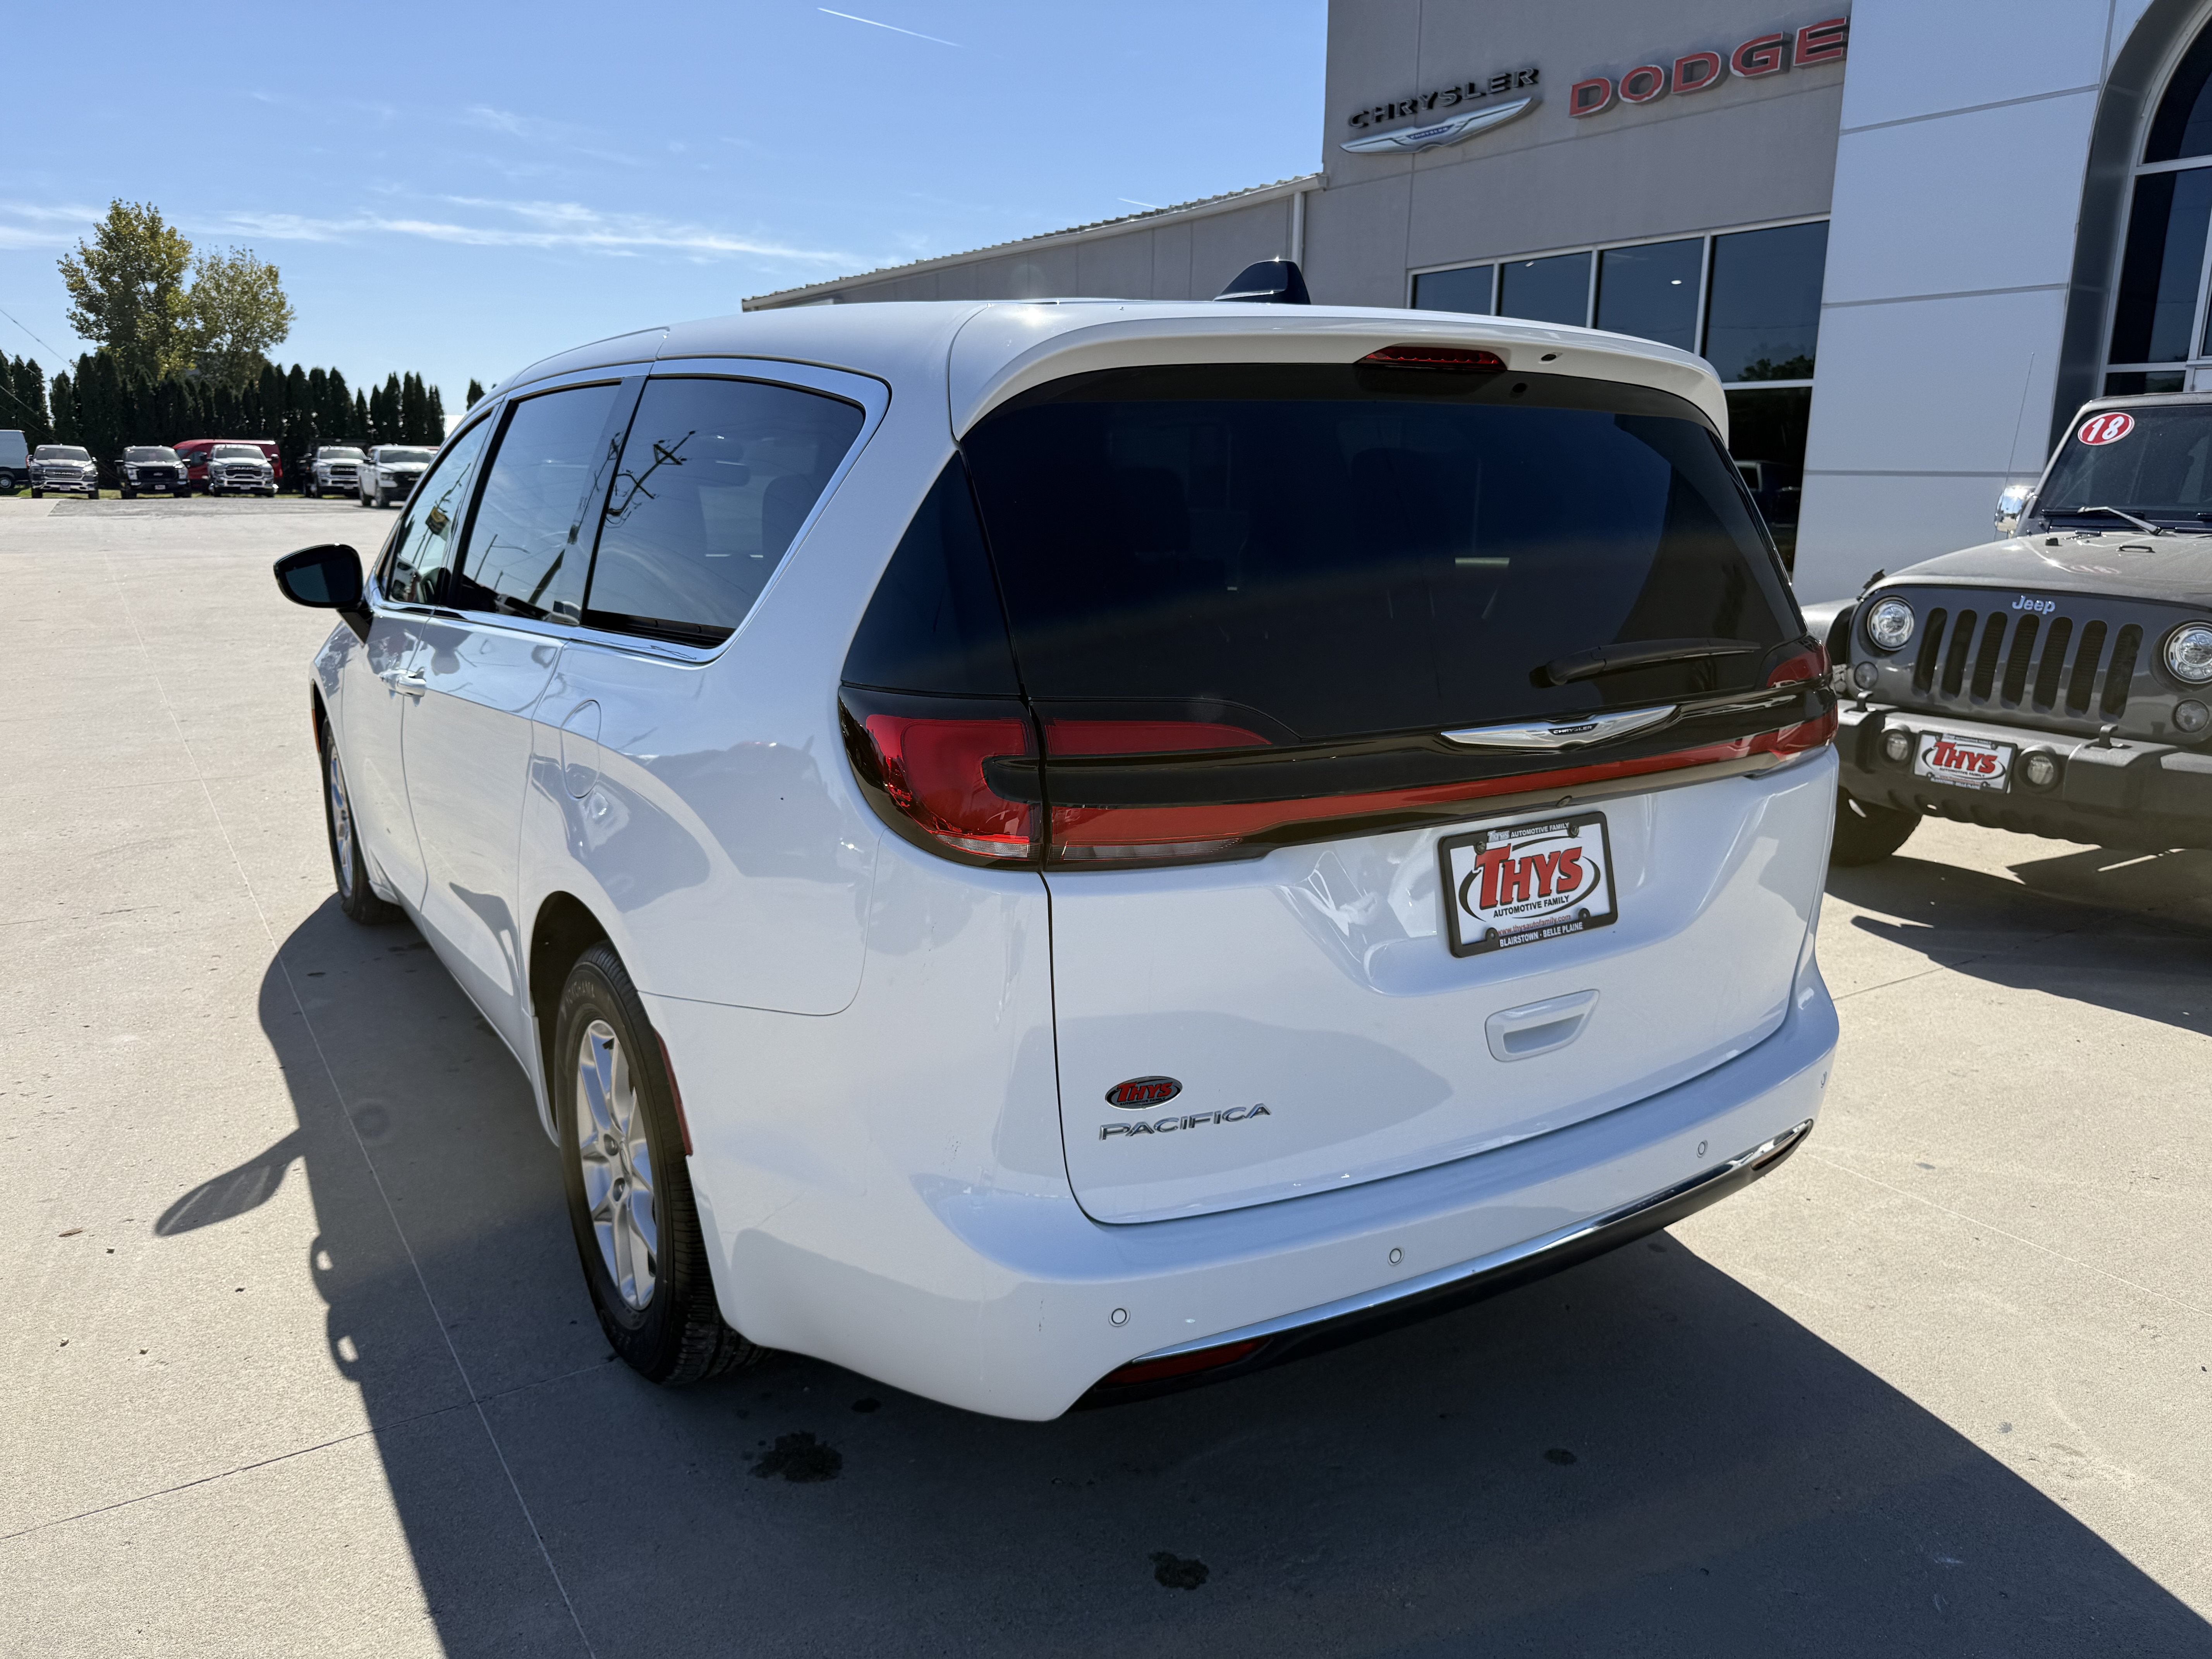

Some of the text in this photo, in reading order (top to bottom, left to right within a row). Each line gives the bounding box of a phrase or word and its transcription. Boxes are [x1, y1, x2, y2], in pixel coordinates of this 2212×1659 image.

[1570, 15, 1848, 116] DODGE
[1348, 67, 1538, 129] CHRYSLER
[2087, 416, 2124, 441] 18
[2012, 595, 2056, 615] Jeep
[1553, 725, 1592, 734] CHRYSLER
[1932, 741, 1997, 774] THYS
[1511, 826, 1548, 838] AUTOMOTIVE
[1549, 822, 1569, 831] FAMILY
[1474, 843, 1582, 910] THYS
[1493, 895, 1570, 918] AUTOMOTIVE FAMILY
[1497, 914, 1571, 936] www.thysautofamily.com
[1499, 931, 1539, 947] BLAIRSTOWN
[1543, 926, 1561, 938] BELLE
[1562, 921, 1583, 934] PLAINE
[1116, 1082, 1173, 1102] THYS
[1099, 1103, 1272, 1140] PACIFICA
